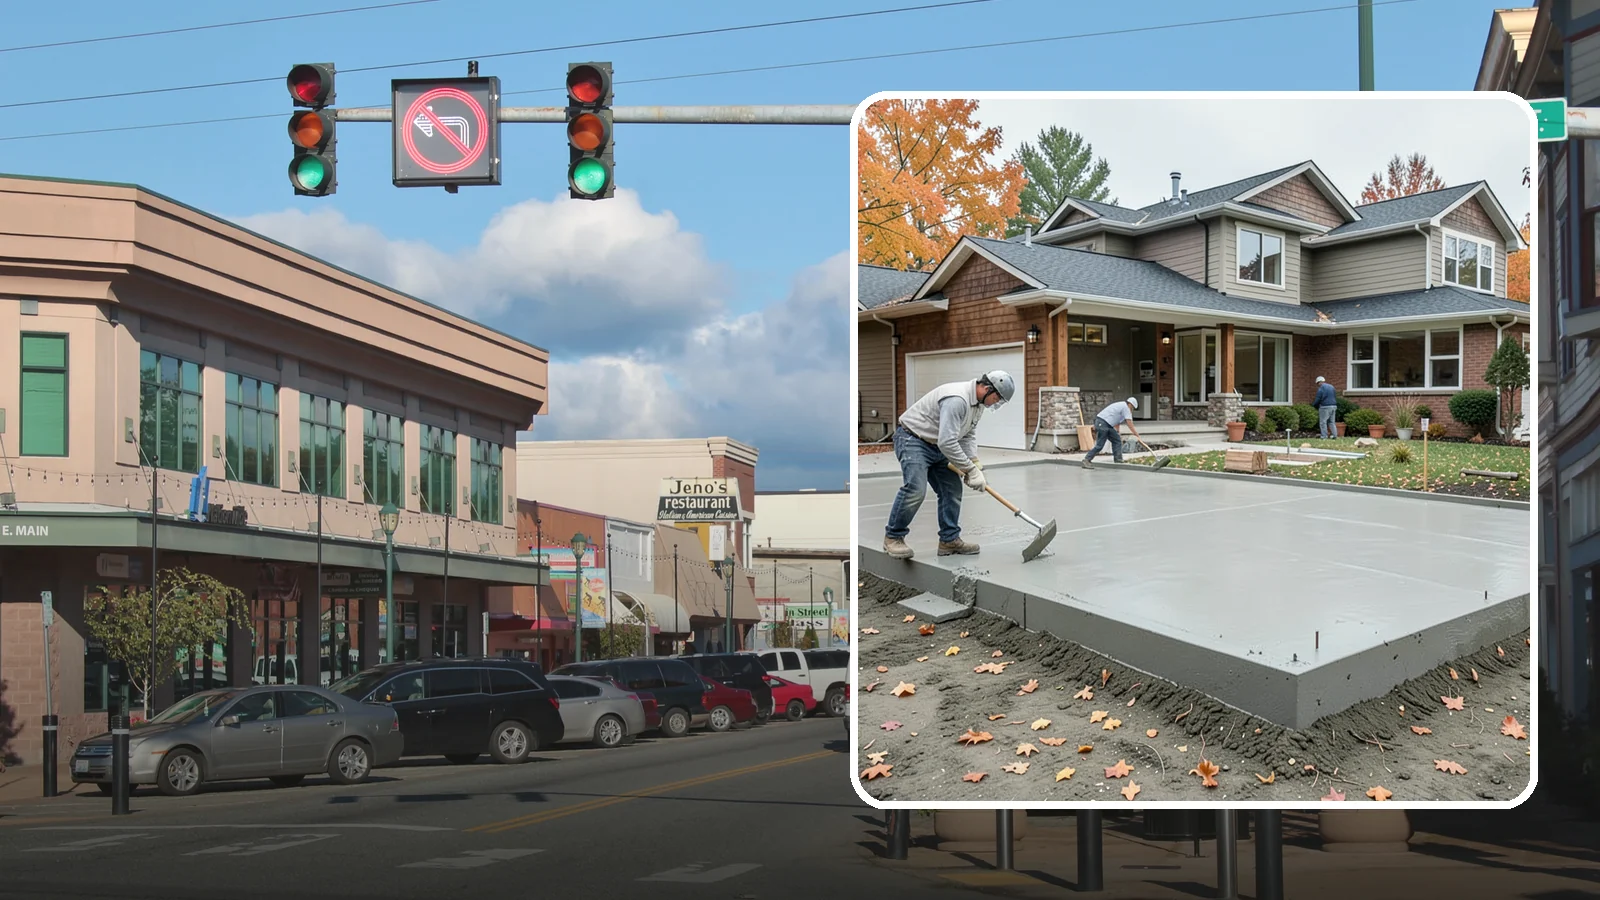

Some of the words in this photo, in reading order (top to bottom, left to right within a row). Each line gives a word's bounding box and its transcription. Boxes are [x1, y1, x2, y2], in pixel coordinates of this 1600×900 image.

[670, 480, 727, 494] Jeno's
[665, 496, 731, 509] restaurant
[658, 510, 682, 519] Italian
[686, 510, 714, 519] American
[714, 509, 738, 519] Cuisine
[2, 526, 13, 536] E.
[16, 525, 49, 536] MAIN
[786, 608, 794, 616] in
[797, 608, 828, 616] Street
[791, 619, 823, 627] lass
